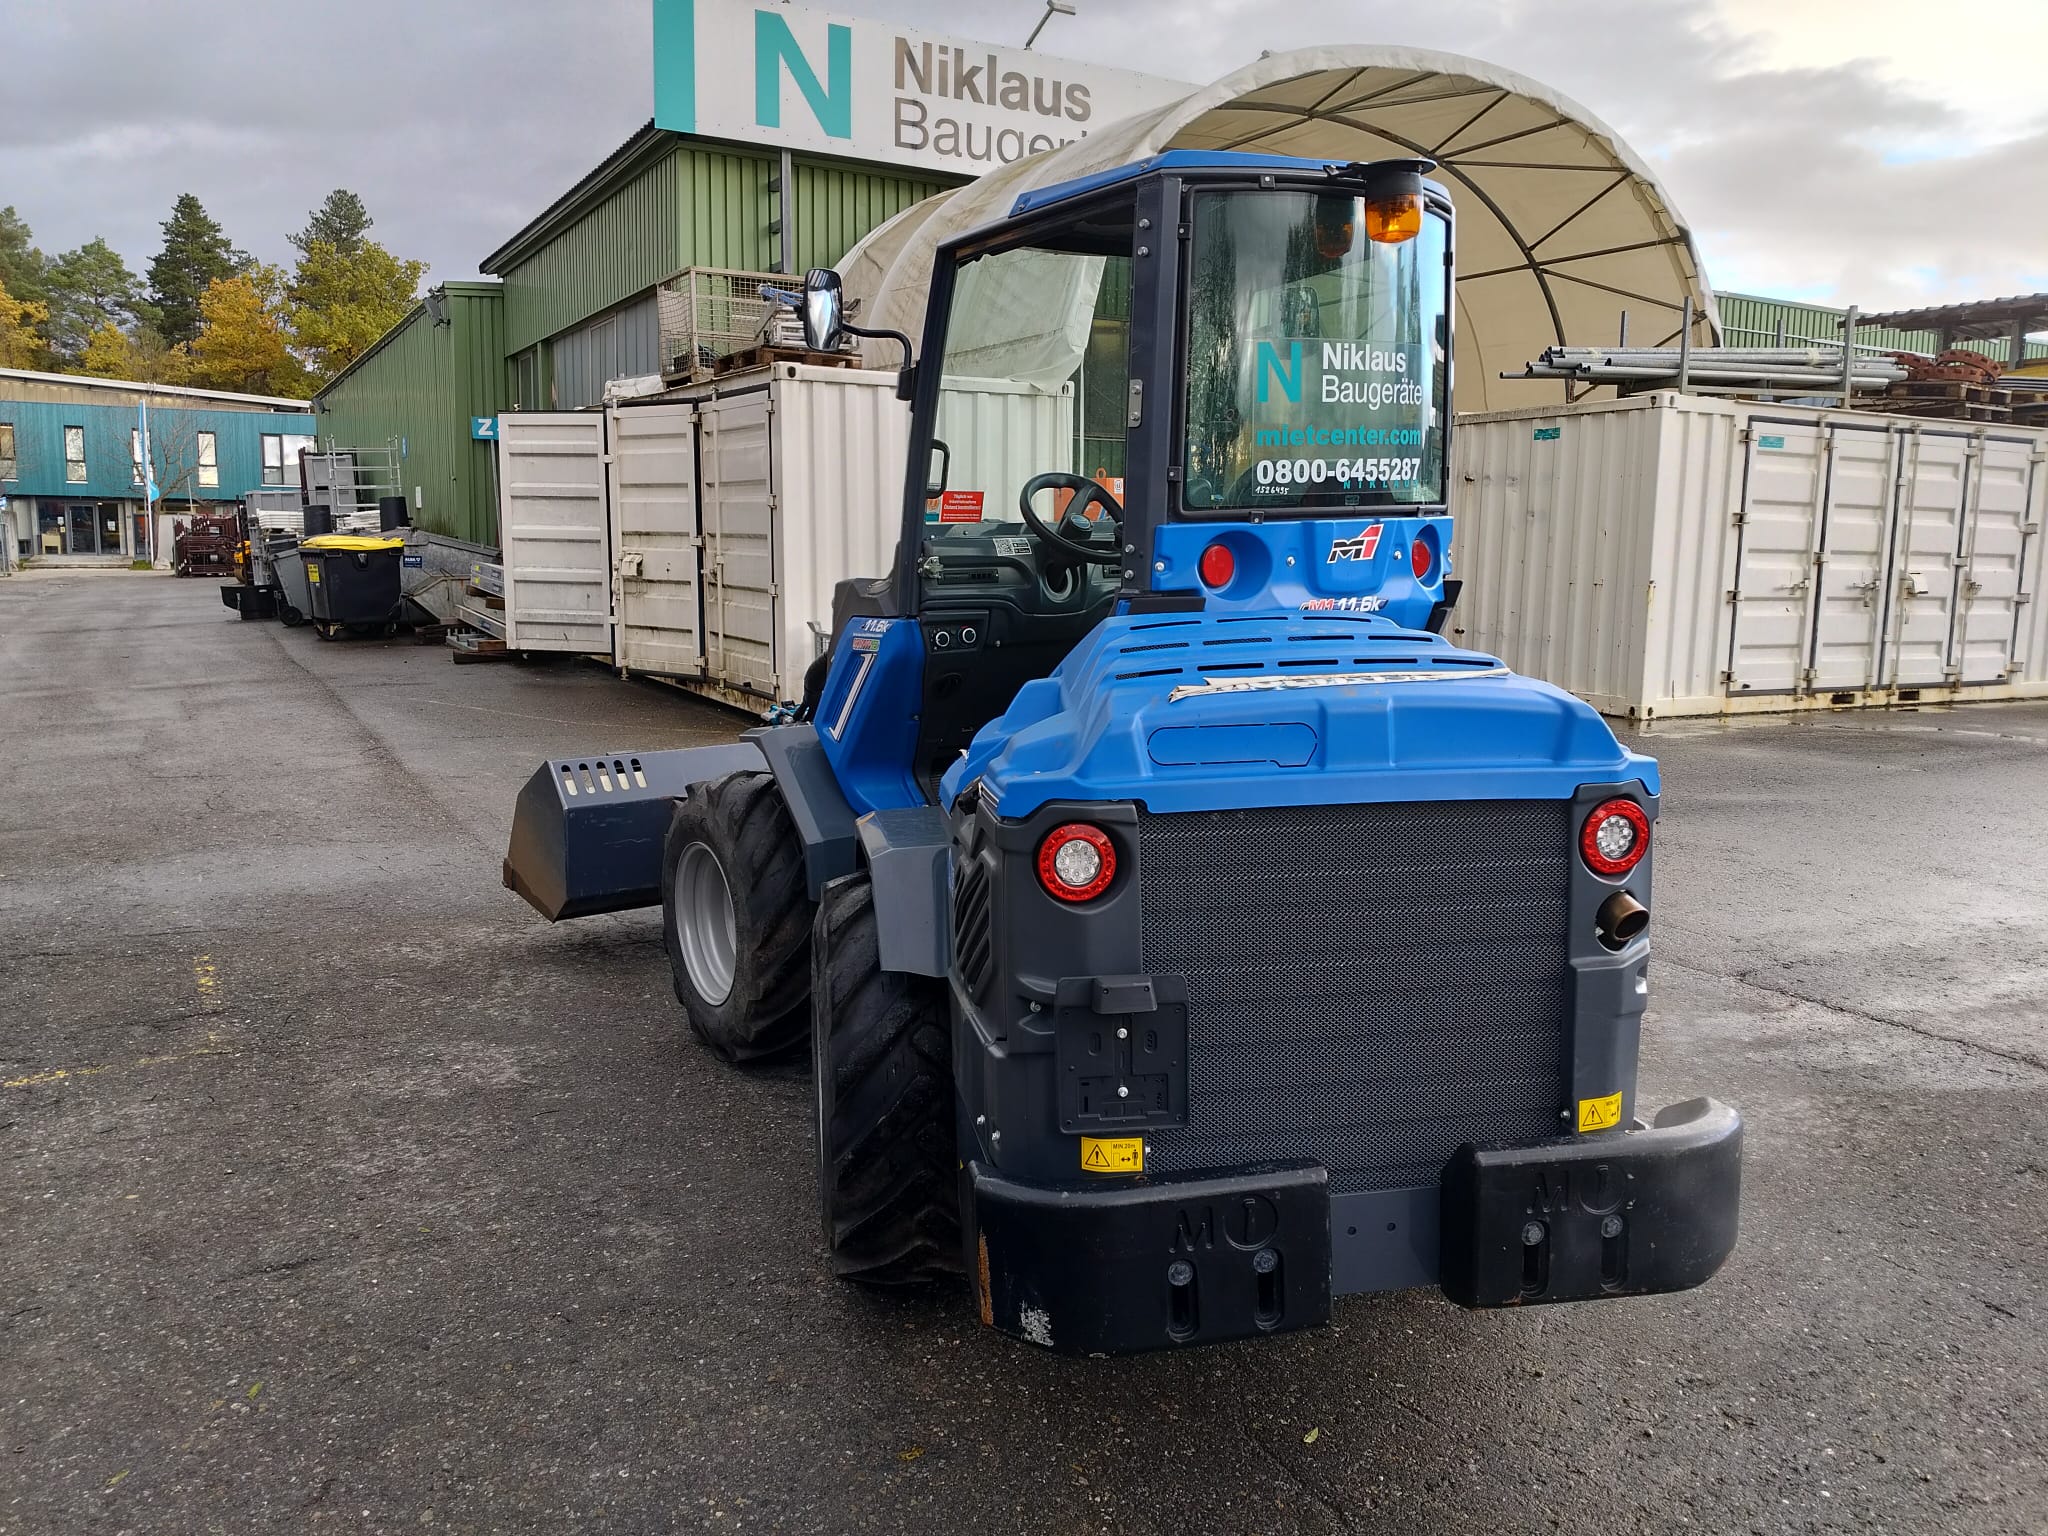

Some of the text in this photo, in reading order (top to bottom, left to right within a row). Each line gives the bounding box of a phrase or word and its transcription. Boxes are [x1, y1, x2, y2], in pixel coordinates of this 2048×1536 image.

[894, 36, 1092, 122] Niklaus
[1322, 342, 1407, 373] Niklaus
[1321, 374, 1422, 411] Baugeräte
[1256, 424, 1421, 447] mietcenter.com
[1256, 458, 1421, 484] 0800-6455287
[1326, 523, 1384, 564] M1
[1337, 596, 1383, 612] 11.6k
